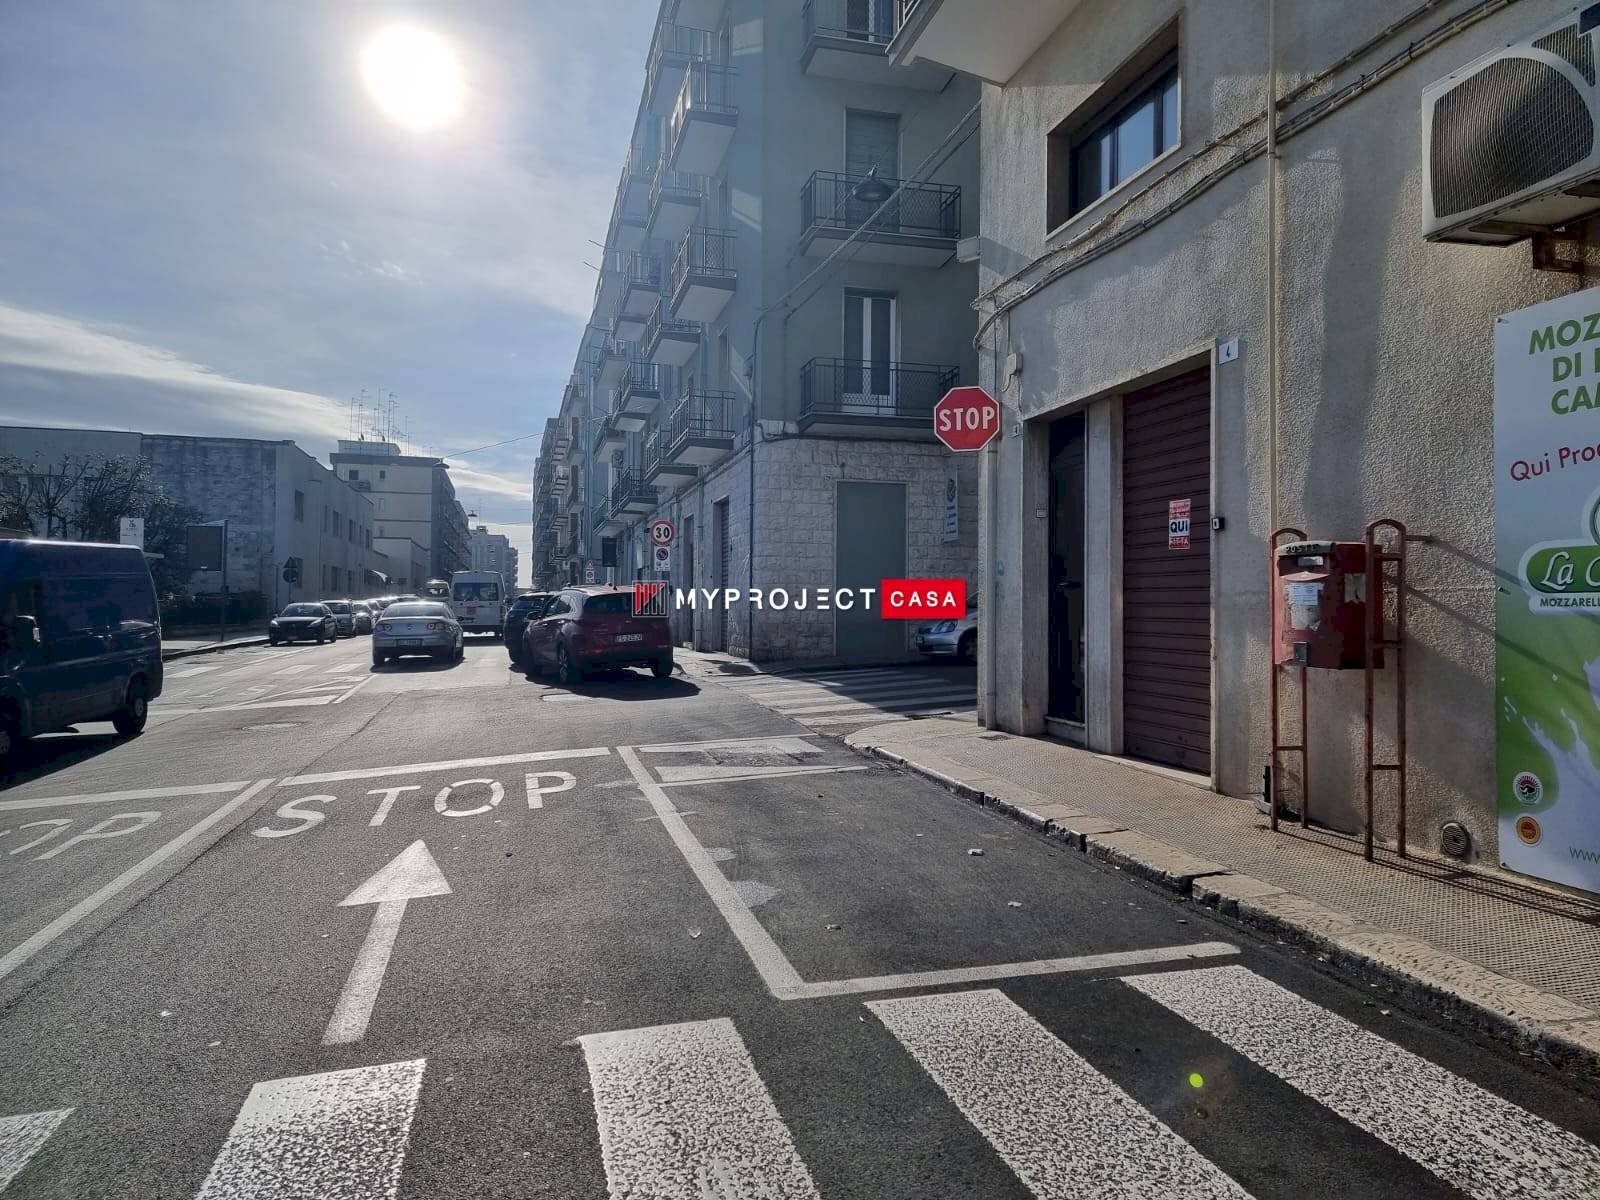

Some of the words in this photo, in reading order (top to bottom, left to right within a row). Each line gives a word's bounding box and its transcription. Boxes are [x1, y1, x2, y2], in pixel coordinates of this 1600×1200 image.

[1552, 352, 1582, 382] DI
[939, 406, 995, 432] STOP
[1510, 452, 1550, 481] Qui
[655, 526, 670, 539] 30
[1170, 520, 1188, 533] QUI
[1540, 551, 1574, 590] La
[251, 771, 577, 838] STOP
